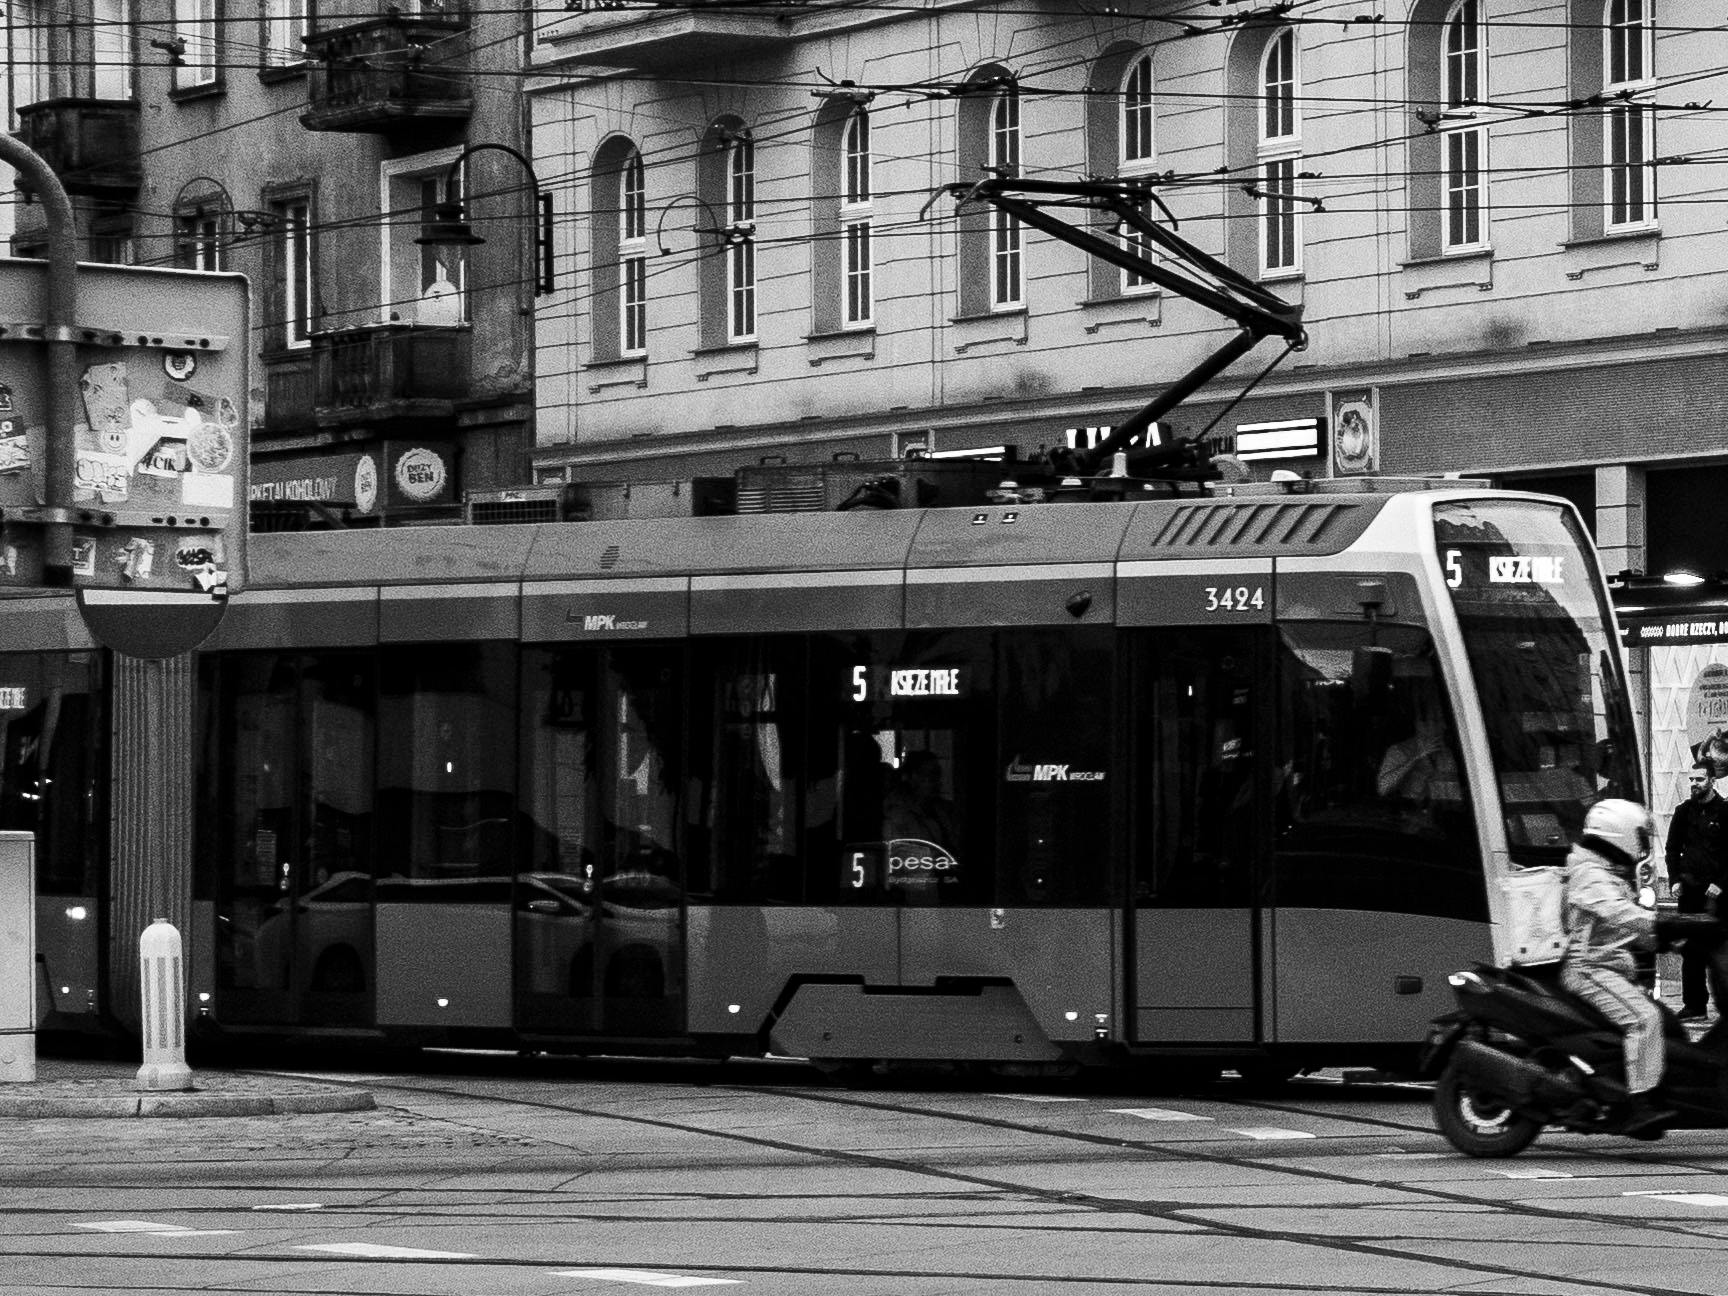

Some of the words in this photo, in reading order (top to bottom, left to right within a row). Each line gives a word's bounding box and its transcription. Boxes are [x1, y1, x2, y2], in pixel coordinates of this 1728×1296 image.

[408, 471, 434, 484] BEN
[1445, 550, 1463, 588] 5
[1204, 586, 1265, 612] 3424
[584, 614, 616, 631] MPK
[853, 665, 867, 702] 5
[1033, 764, 1070, 782] MPK
[852, 852, 865, 888] 5
[888, 855, 951, 874] pesa
